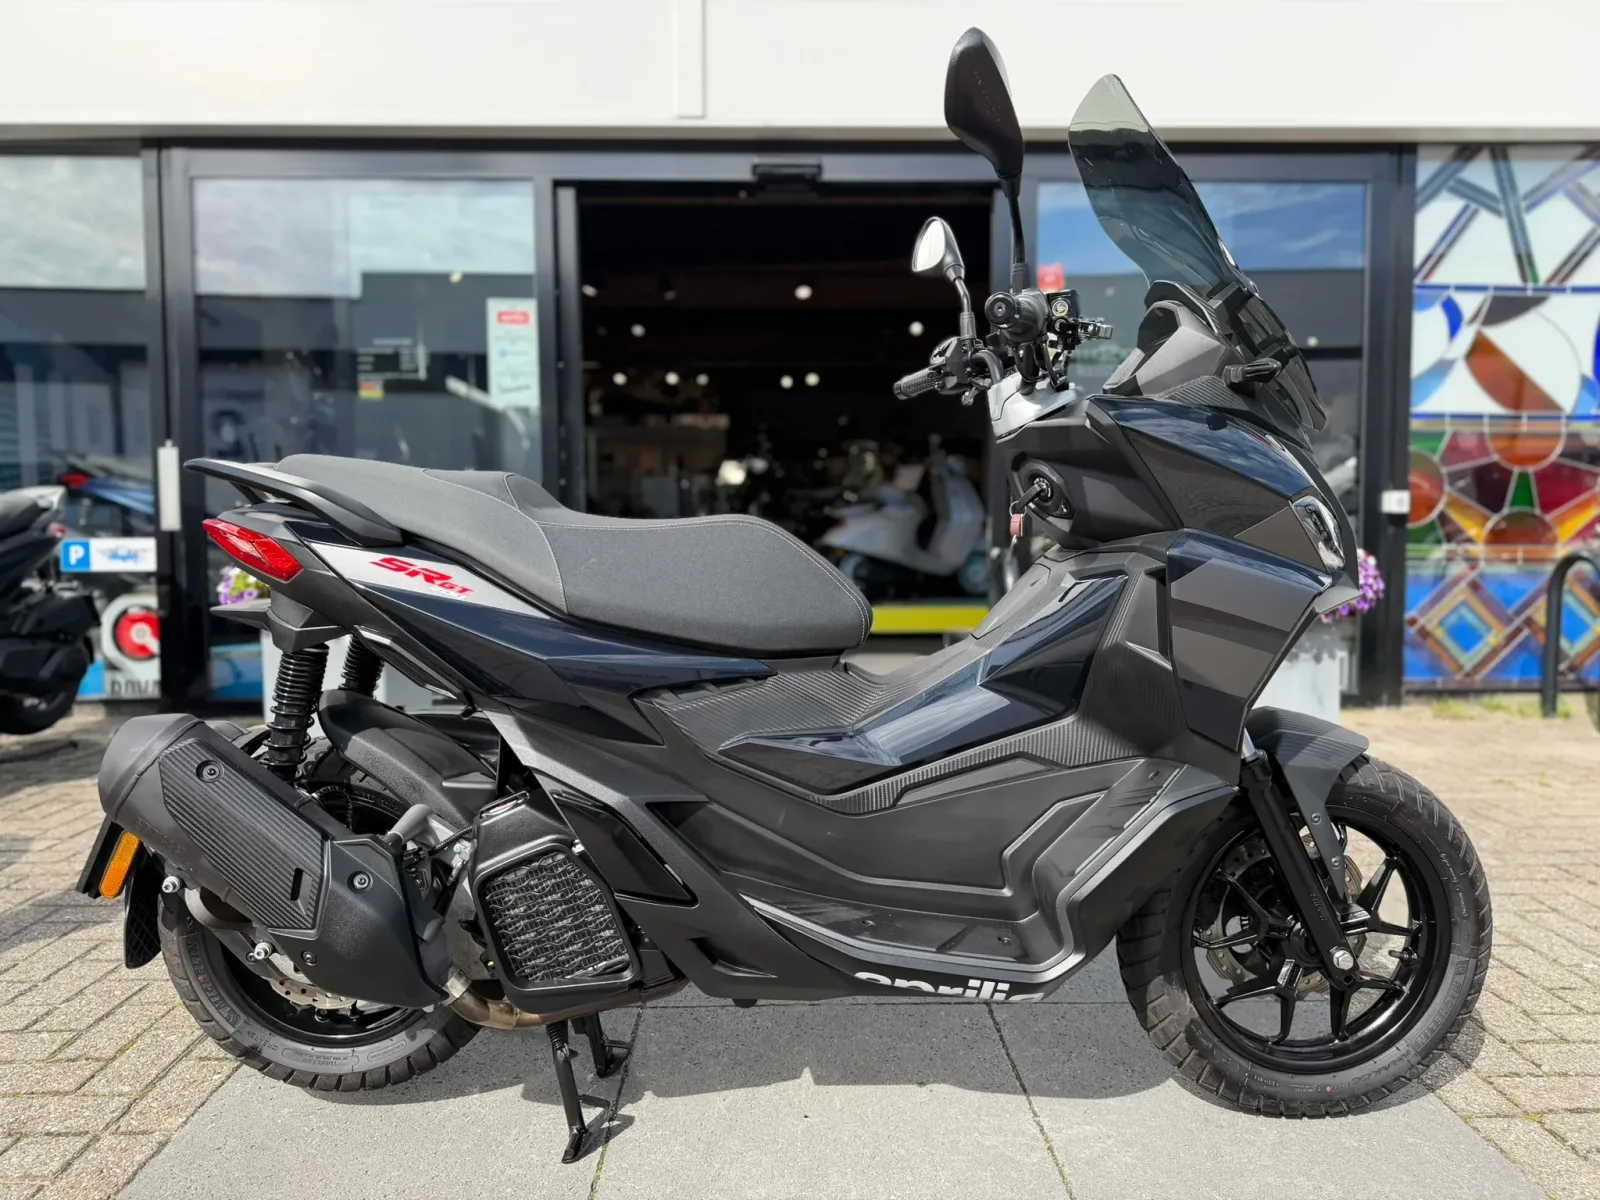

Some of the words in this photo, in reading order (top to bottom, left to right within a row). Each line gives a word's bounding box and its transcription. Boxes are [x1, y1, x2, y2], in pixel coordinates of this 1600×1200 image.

[69, 544, 85, 566] P
[368, 557, 454, 585] SR
[437, 581, 475, 594] GT
[1417, 980, 1463, 1046] MICHELIN
